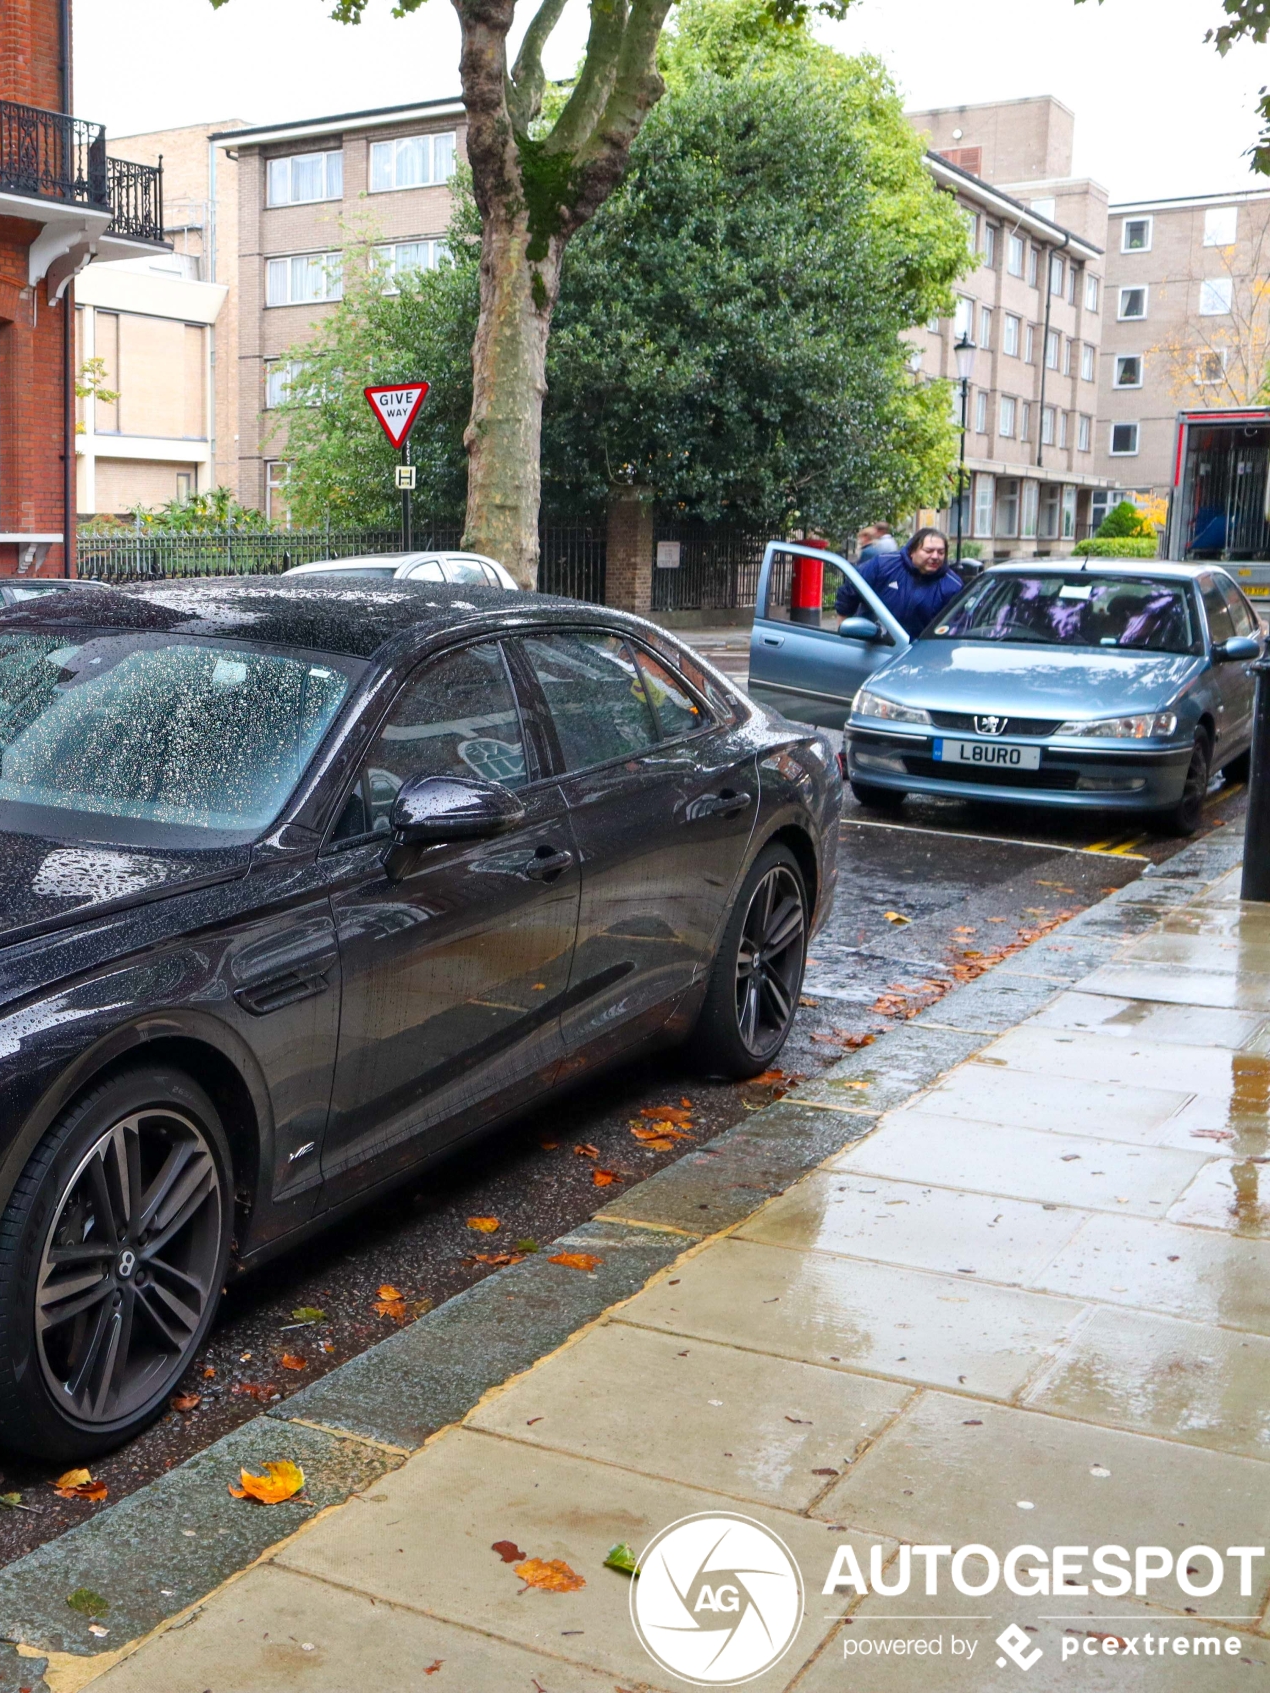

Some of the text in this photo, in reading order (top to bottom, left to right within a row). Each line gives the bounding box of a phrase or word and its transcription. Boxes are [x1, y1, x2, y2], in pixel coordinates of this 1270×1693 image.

[379, 392, 413, 406] GIVE
[386, 407, 408, 418] WAY
[960, 744, 1021, 764] L8URO
